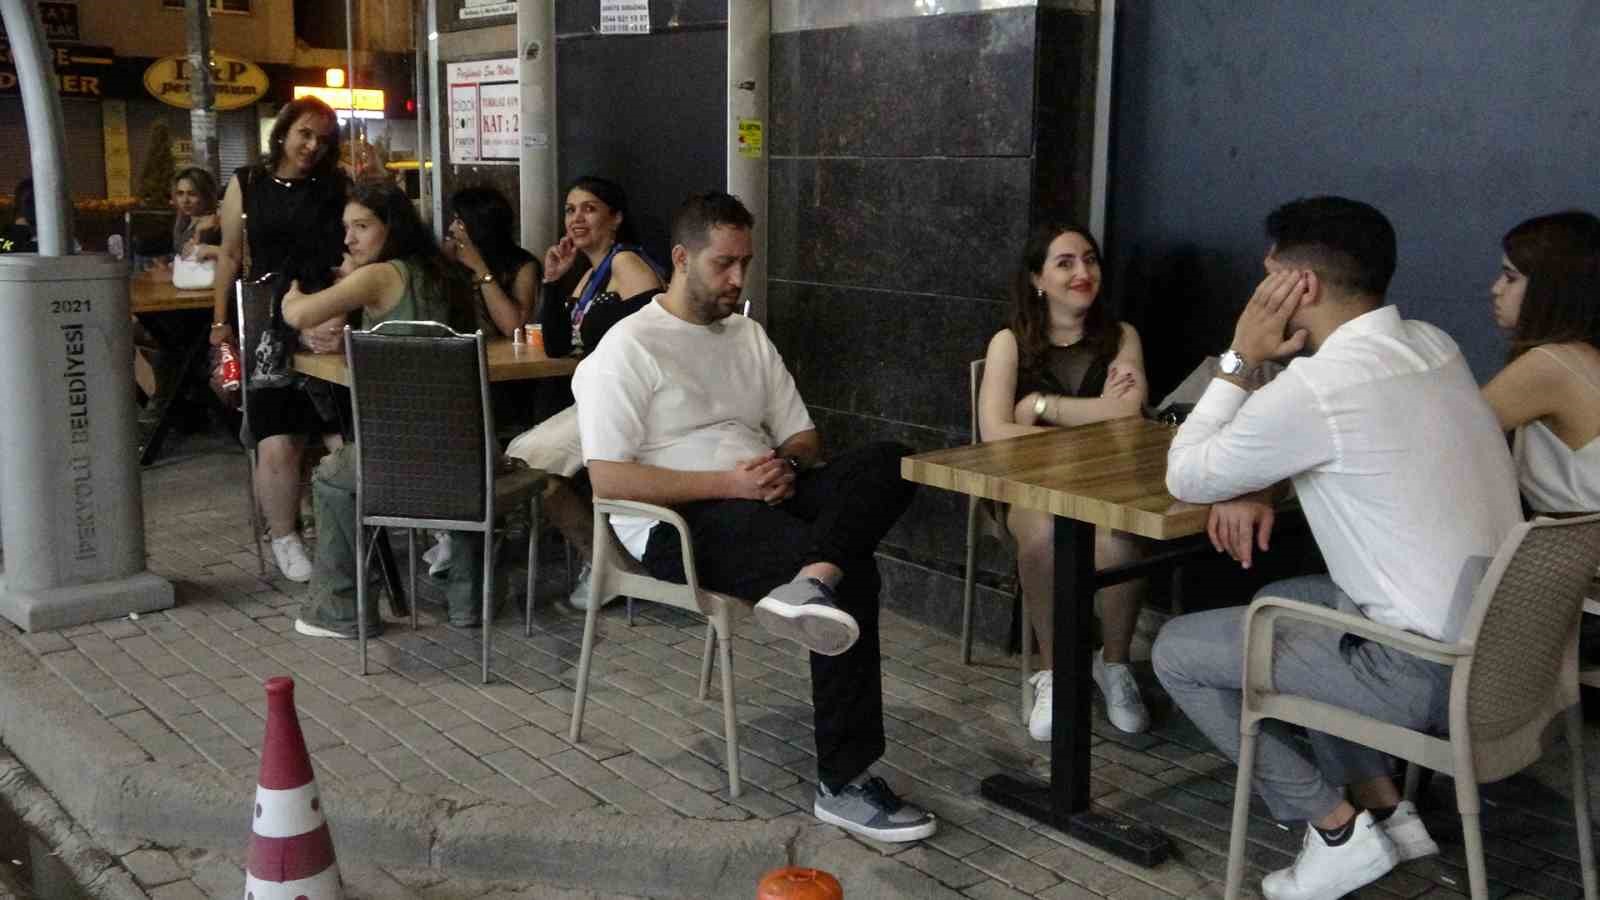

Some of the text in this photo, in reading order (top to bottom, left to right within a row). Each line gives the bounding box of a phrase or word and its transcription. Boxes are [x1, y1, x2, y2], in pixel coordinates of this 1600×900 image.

[482, 114, 502, 133] KAT
[512, 113, 519, 132] 2
[50, 299, 92, 314] 2021
